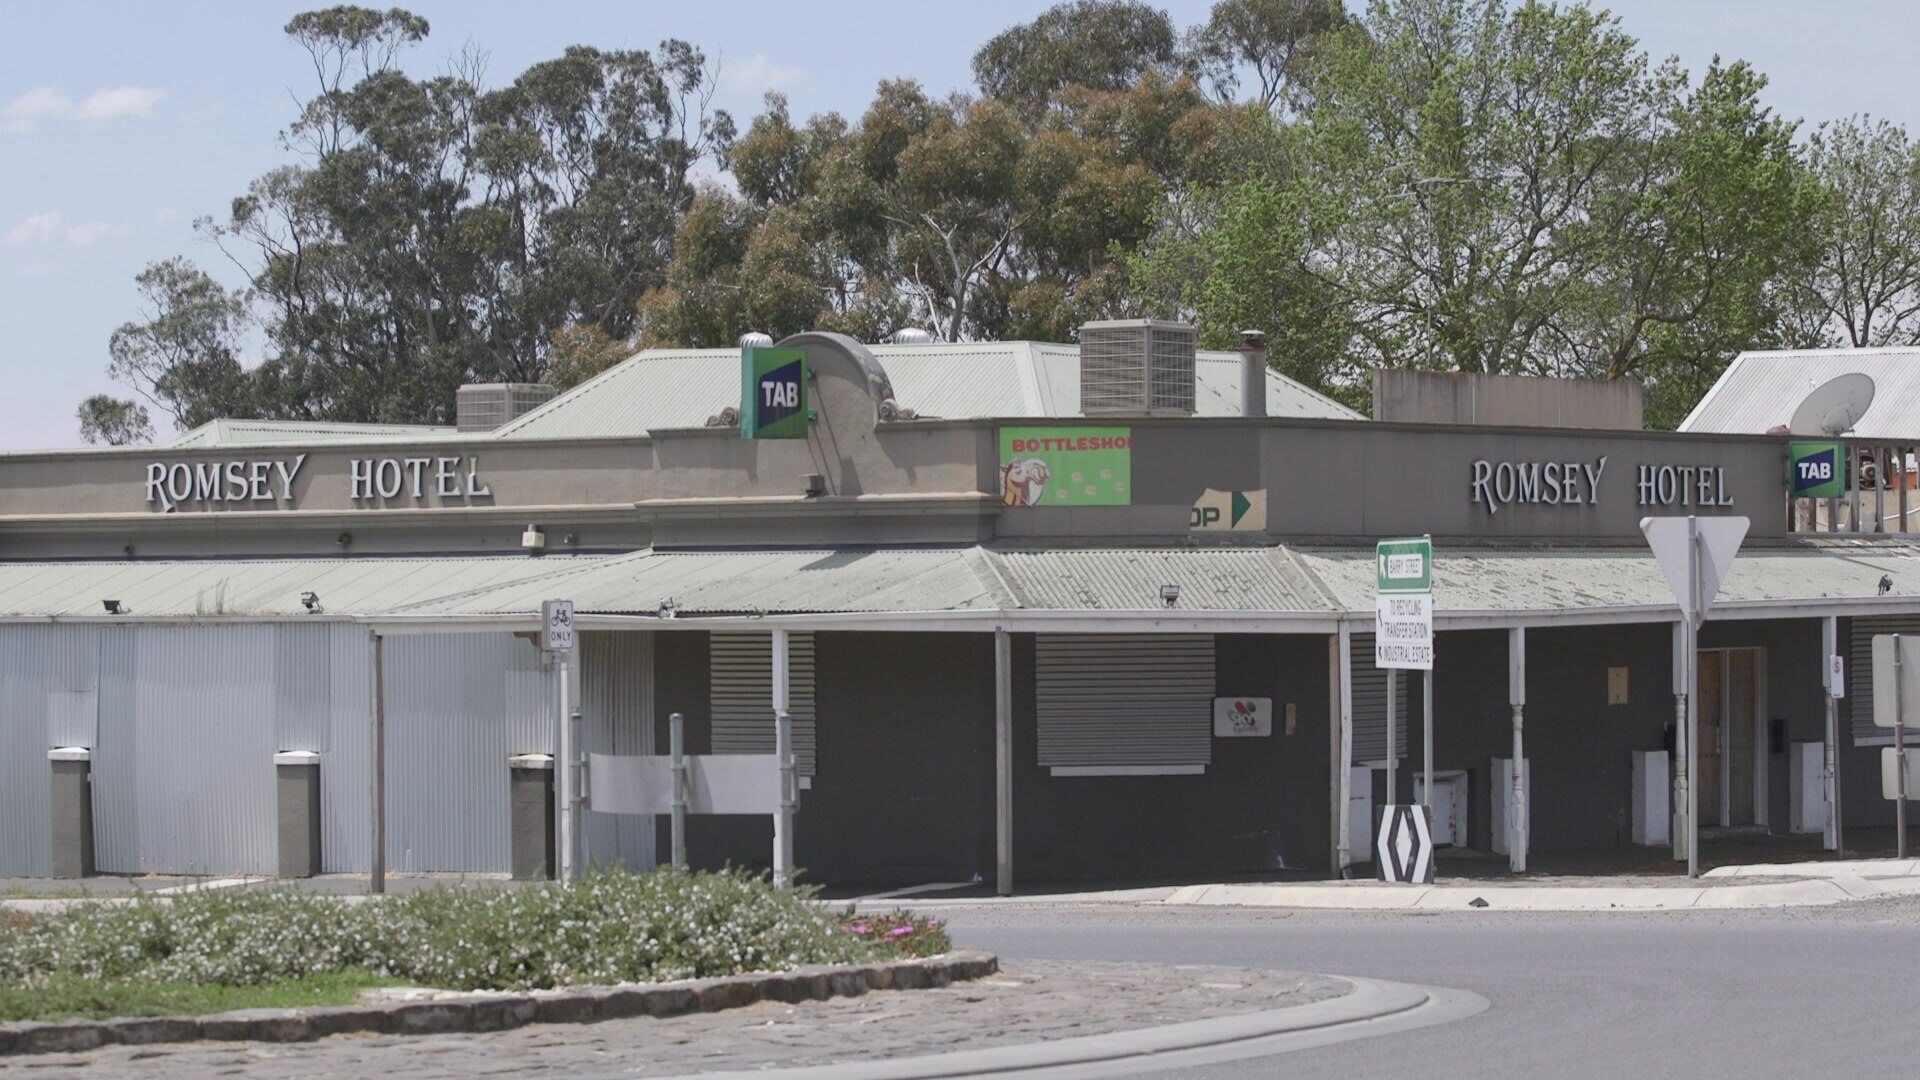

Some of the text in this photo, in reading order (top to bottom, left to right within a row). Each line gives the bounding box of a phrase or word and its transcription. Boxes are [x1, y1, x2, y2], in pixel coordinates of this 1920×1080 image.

[761, 381, 799, 408] TAB
[1798, 462, 1832, 480] TAB
[145, 452, 490, 513] ROMSEY HOTEL
[1471, 455, 1735, 515] ROMSEY HOTEL
[1389, 558, 1421, 574] BARRY STREET
[1389, 599, 1422, 616] TO RECYCLING
[551, 631, 571, 641] ONLY
[1384, 622, 1428, 639] TRANSFER STATION
[1383, 646, 1430, 663] INDUSTRIAL ESTATE
